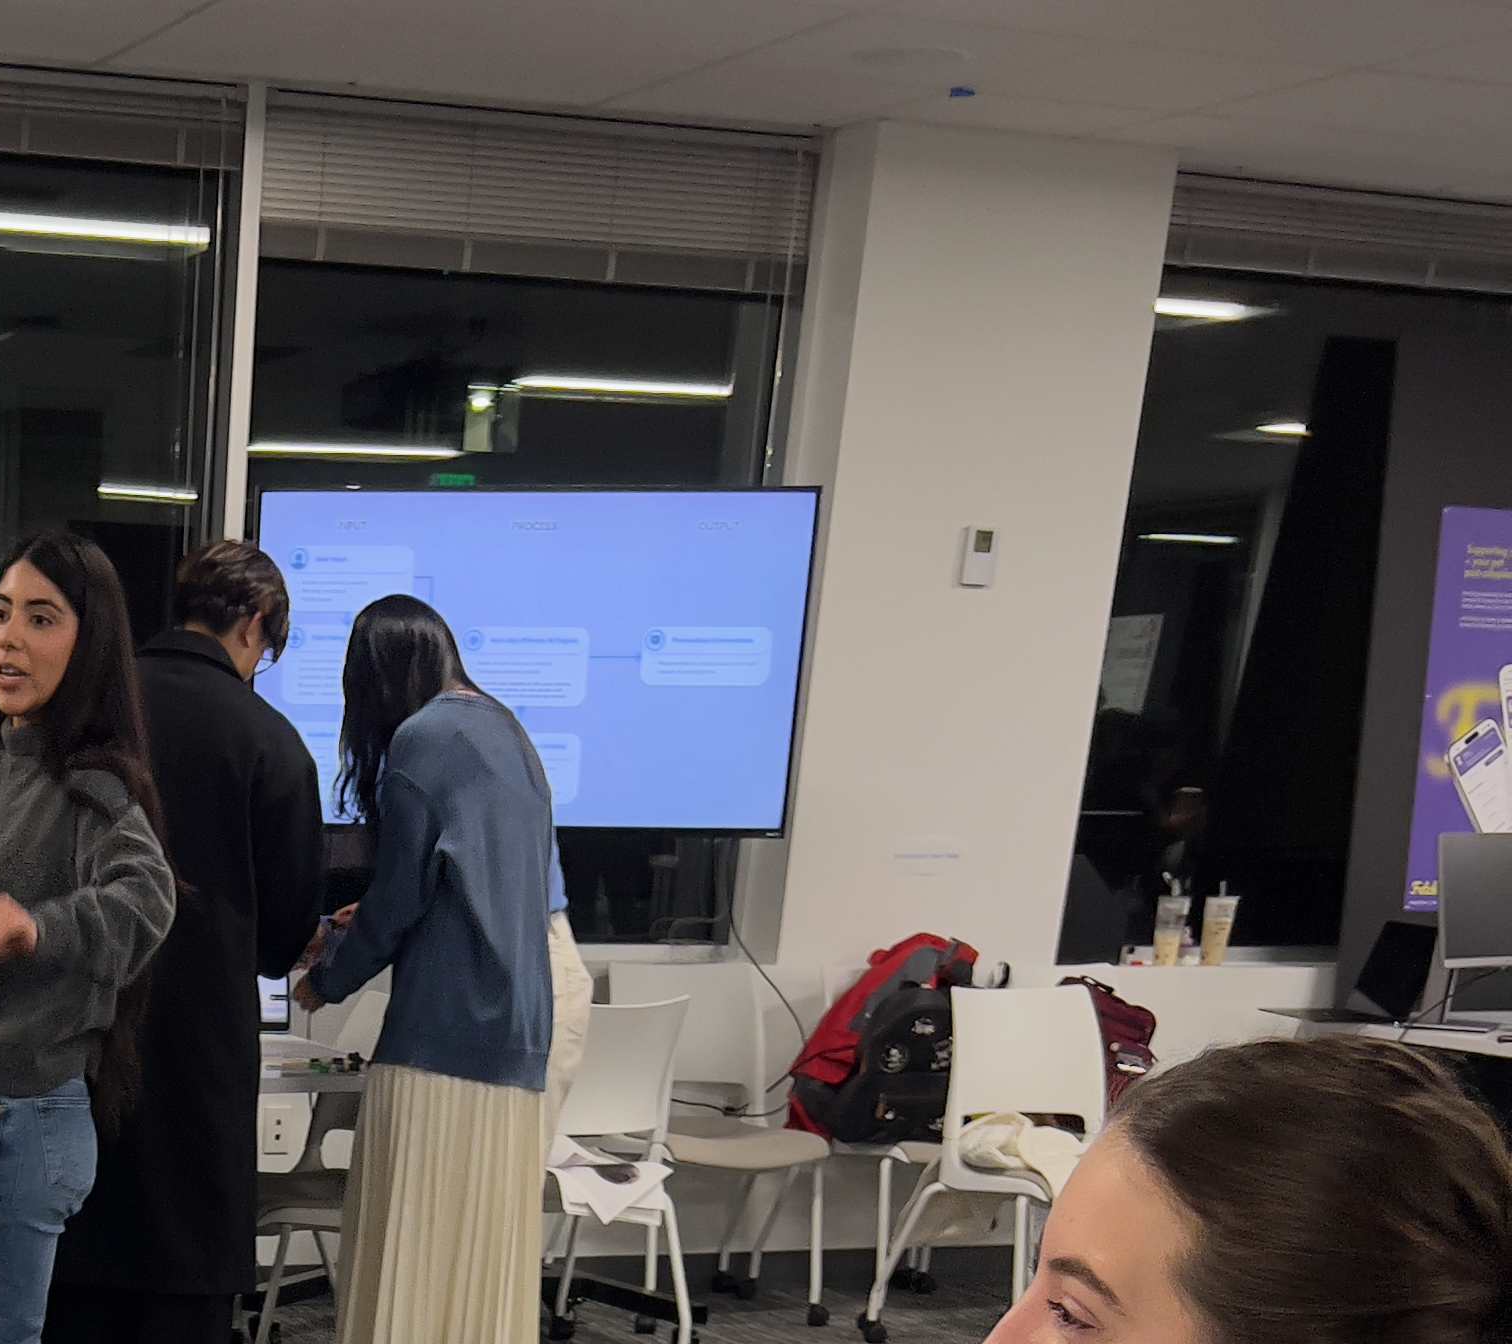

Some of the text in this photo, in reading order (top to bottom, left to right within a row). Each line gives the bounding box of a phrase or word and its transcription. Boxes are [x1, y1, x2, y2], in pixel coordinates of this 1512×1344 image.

[337, 520, 367, 532] INPUT
[511, 520, 557, 532] PROCESS
[698, 520, 740, 532] OUTPUT
